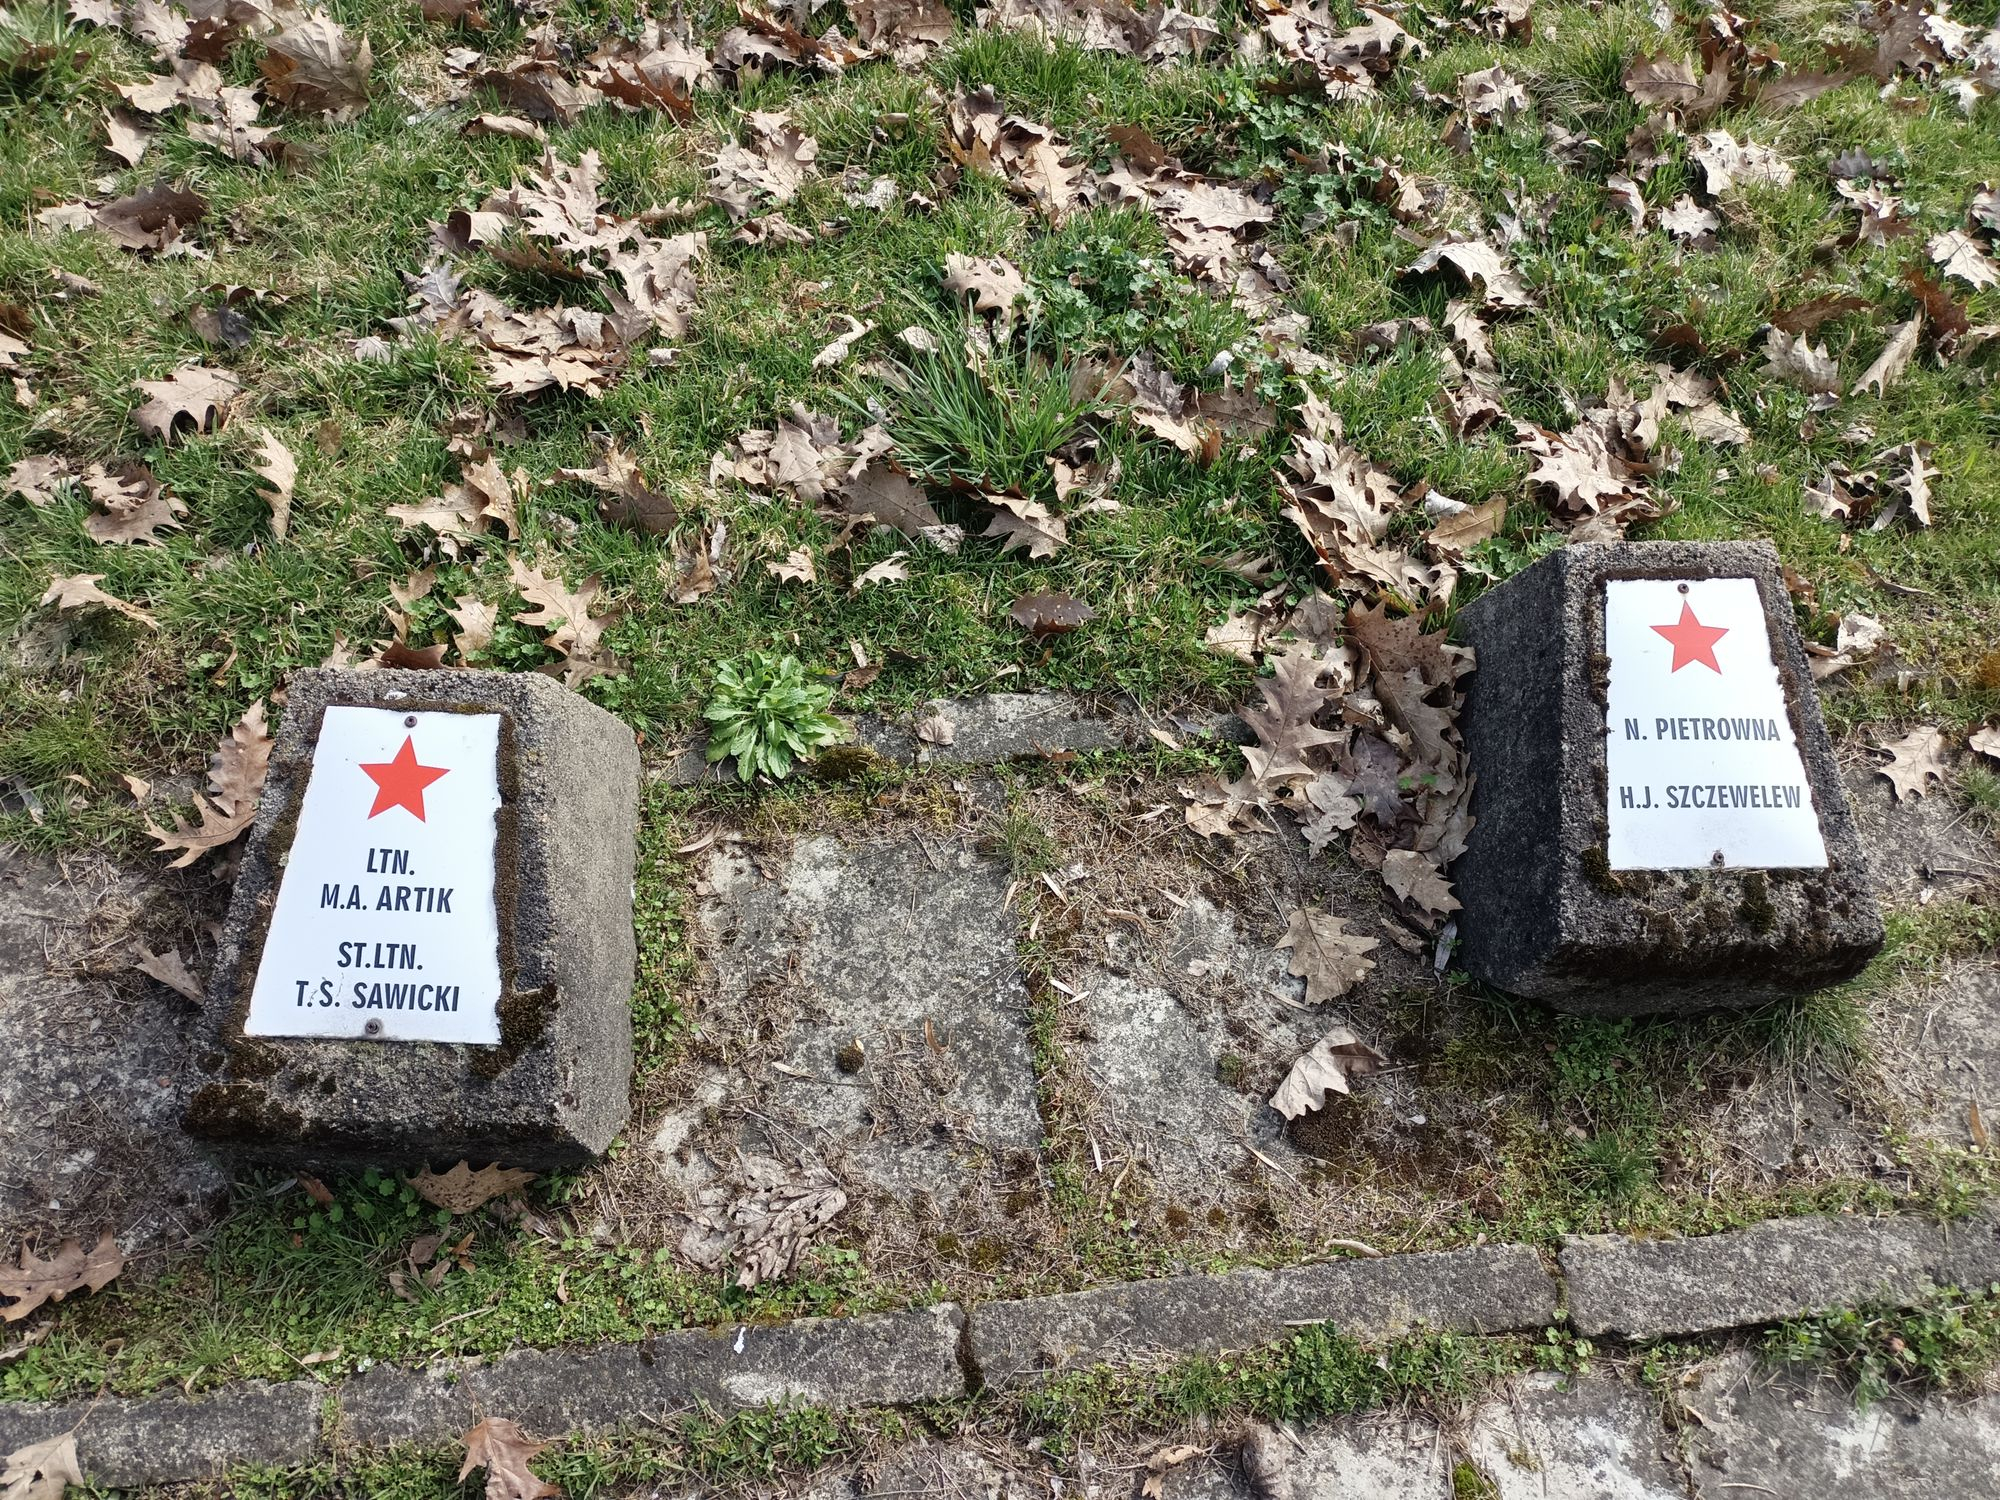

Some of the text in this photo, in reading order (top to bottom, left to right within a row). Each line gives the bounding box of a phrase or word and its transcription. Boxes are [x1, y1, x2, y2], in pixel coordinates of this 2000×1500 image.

[1624, 718, 1780, 741] N. PIETROWNA
[1619, 785, 1802, 810] H.J. SZCZEWELEW
[366, 847, 415, 876] LTN.
[320, 883, 454, 914] M.A. ARTIK
[337, 941, 423, 970] ST.LTN.
[351, 981, 460, 1012] SAWICKI
